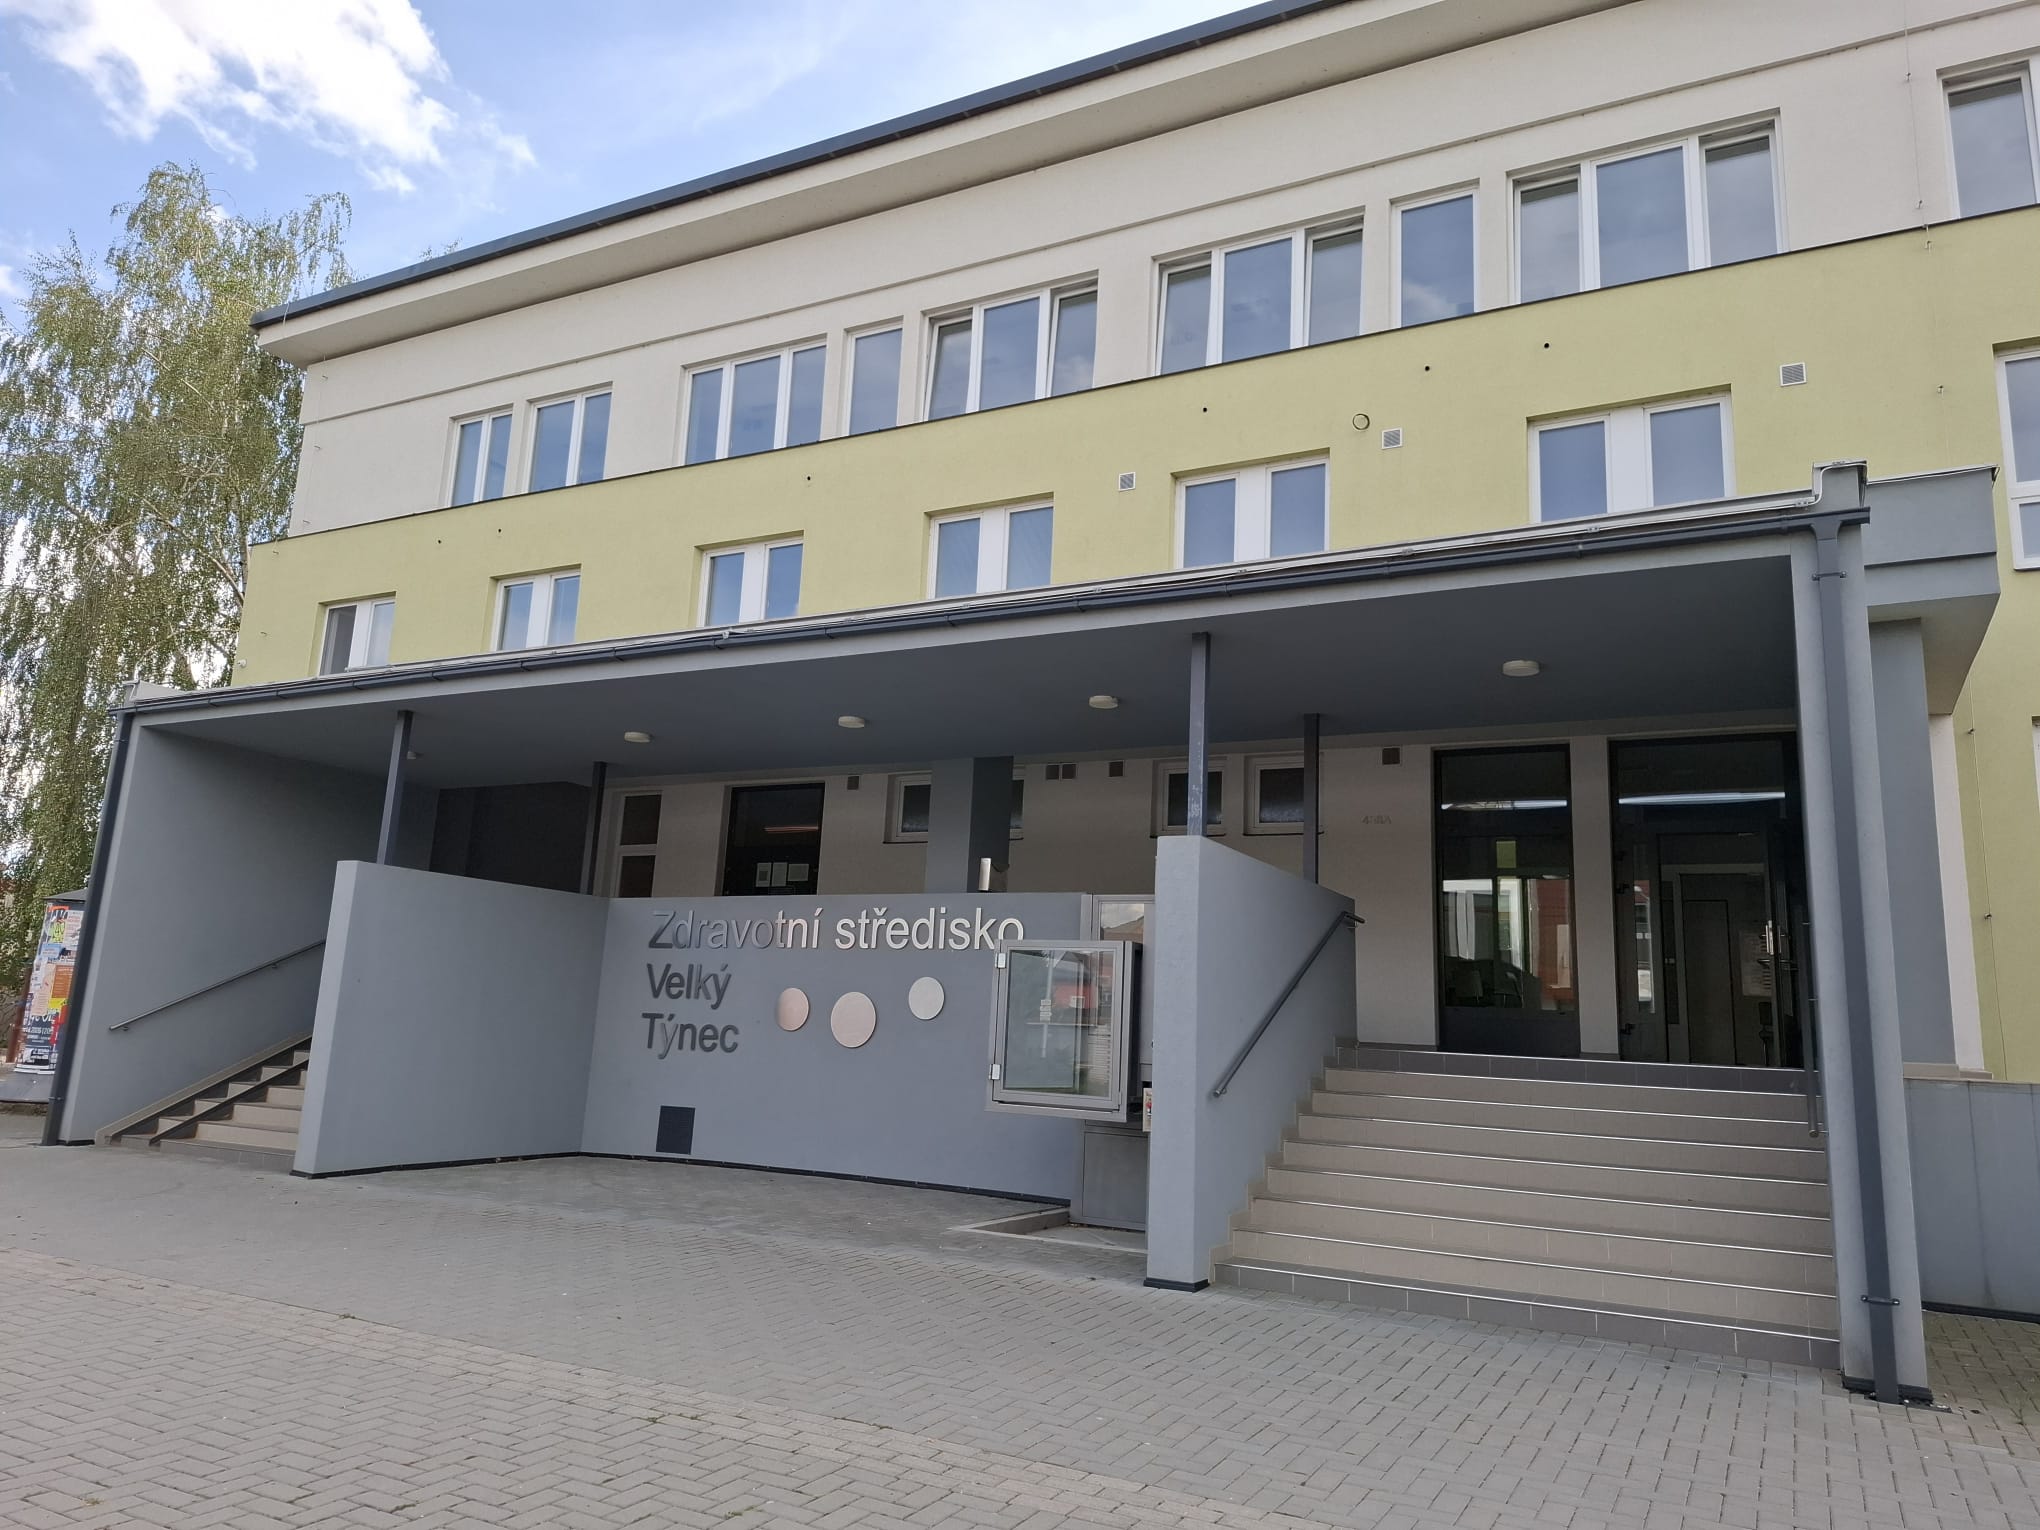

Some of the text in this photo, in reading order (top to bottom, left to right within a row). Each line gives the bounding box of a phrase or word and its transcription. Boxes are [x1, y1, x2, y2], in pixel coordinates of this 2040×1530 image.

[648, 906, 1025, 950] Zdravotní středisko
[647, 962, 733, 1010] Velký
[641, 1012, 740, 1060] Týnec
